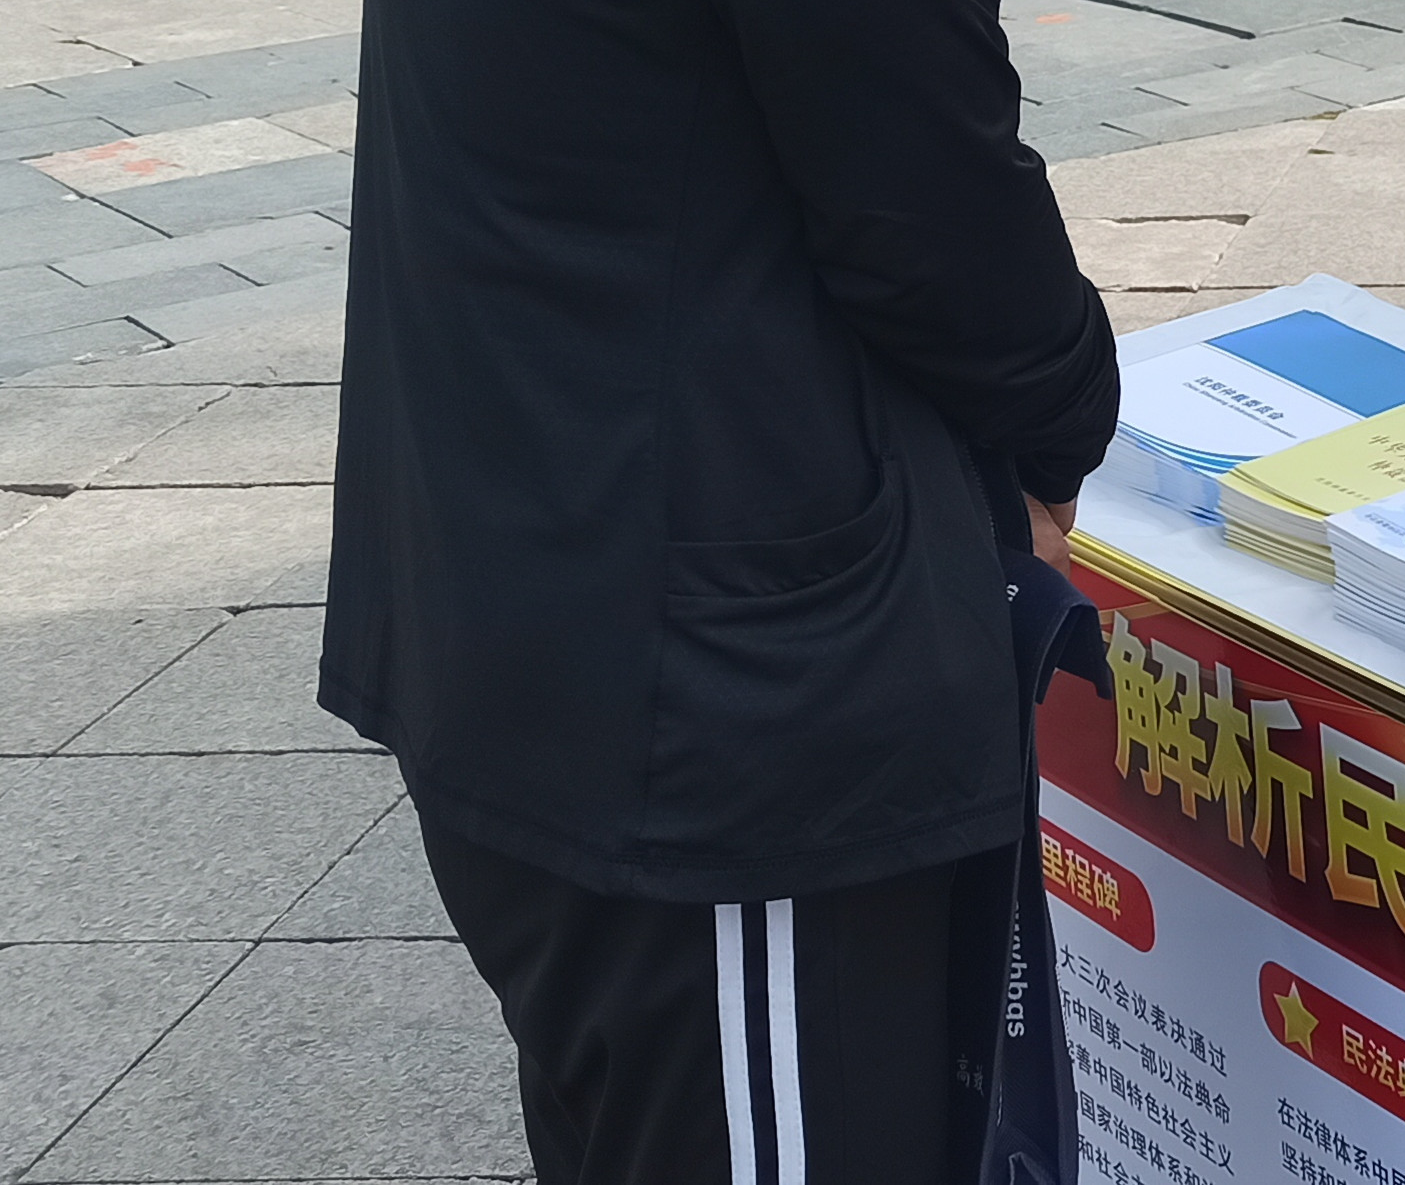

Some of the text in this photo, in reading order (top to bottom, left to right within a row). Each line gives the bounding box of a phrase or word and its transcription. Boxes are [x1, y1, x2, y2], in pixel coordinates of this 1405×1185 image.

[1041, 830, 1122, 922] 里程碑
[1060, 943, 1228, 1079] 大三次会议表决通过
[1080, 1089, 1219, 1185] 国家治理体系和
[1281, 1139, 1349, 1185] 坚持和
